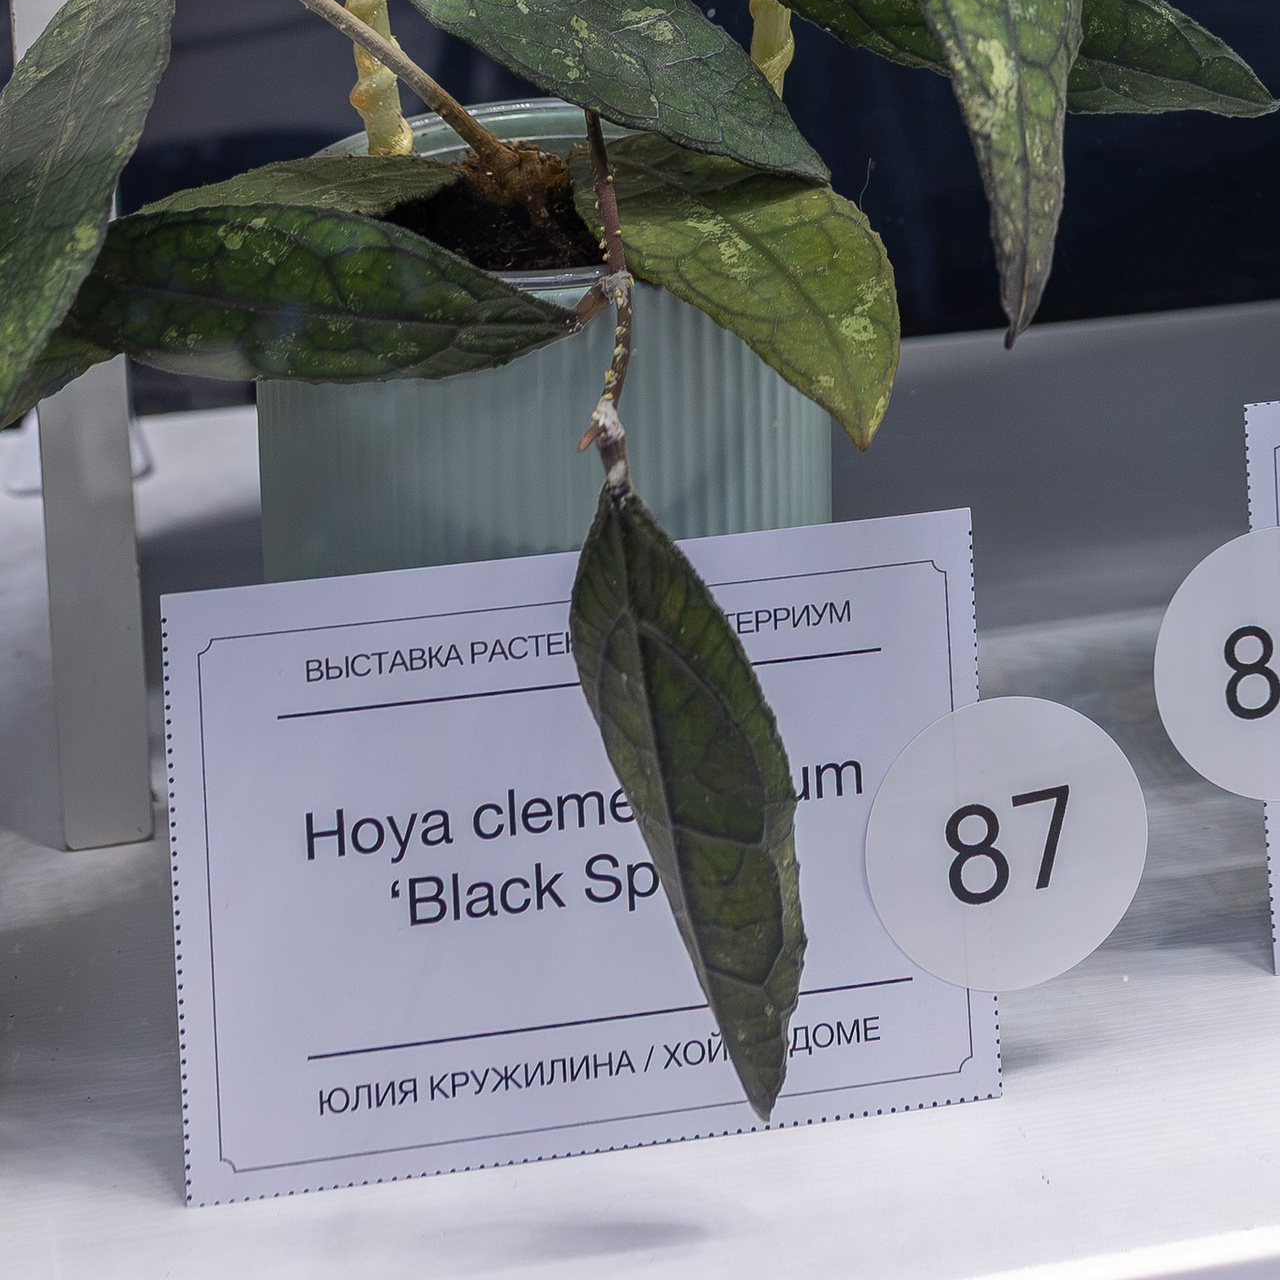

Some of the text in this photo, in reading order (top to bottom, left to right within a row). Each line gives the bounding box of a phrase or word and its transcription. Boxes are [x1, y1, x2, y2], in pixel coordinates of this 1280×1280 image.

[305, 643, 465, 683] ВЫСТАВКА
[469, 630, 573, 665] РАСТЕ
[305, 806, 454, 865] Hoya
[945, 784, 1070, 905] 87
[390, 861, 566, 927] ‘Black
[318, 1077, 418, 1116] ЮЛИЯ
[429, 1049, 637, 1101] КРУЖИЛИНА
[663, 1031, 732, 1070] ХОЙ
[789, 1016, 882, 1058] ДОМЕ
